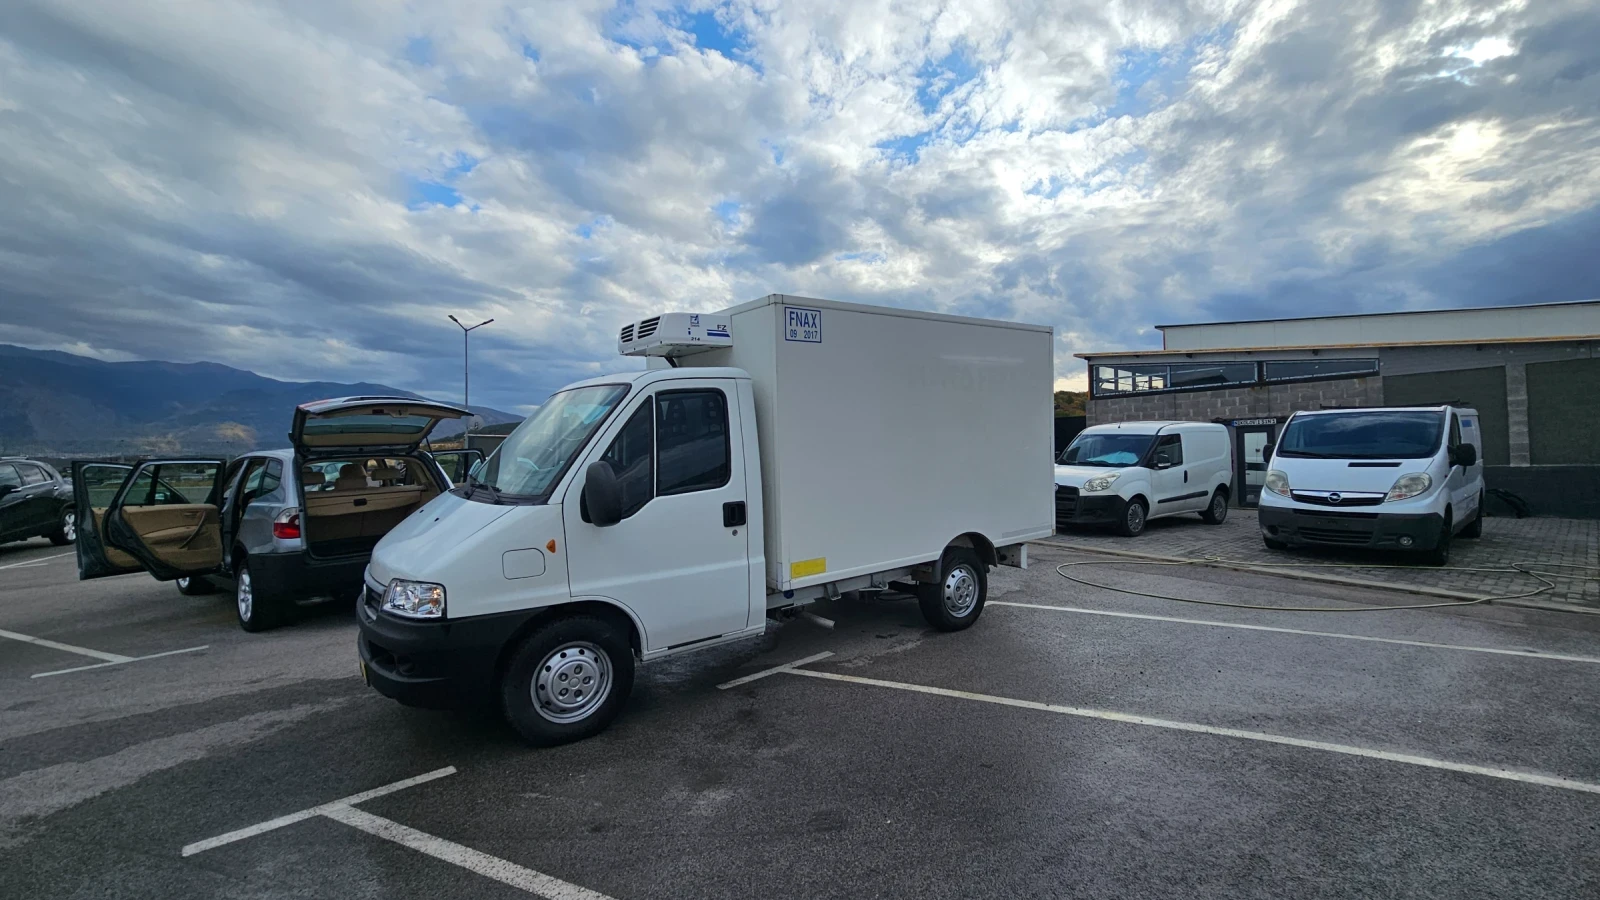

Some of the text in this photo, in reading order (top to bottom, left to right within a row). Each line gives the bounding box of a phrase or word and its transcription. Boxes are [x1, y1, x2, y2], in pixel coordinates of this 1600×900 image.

[789, 310, 818, 329] FNAX
[789, 329, 819, 340] 09 2017
